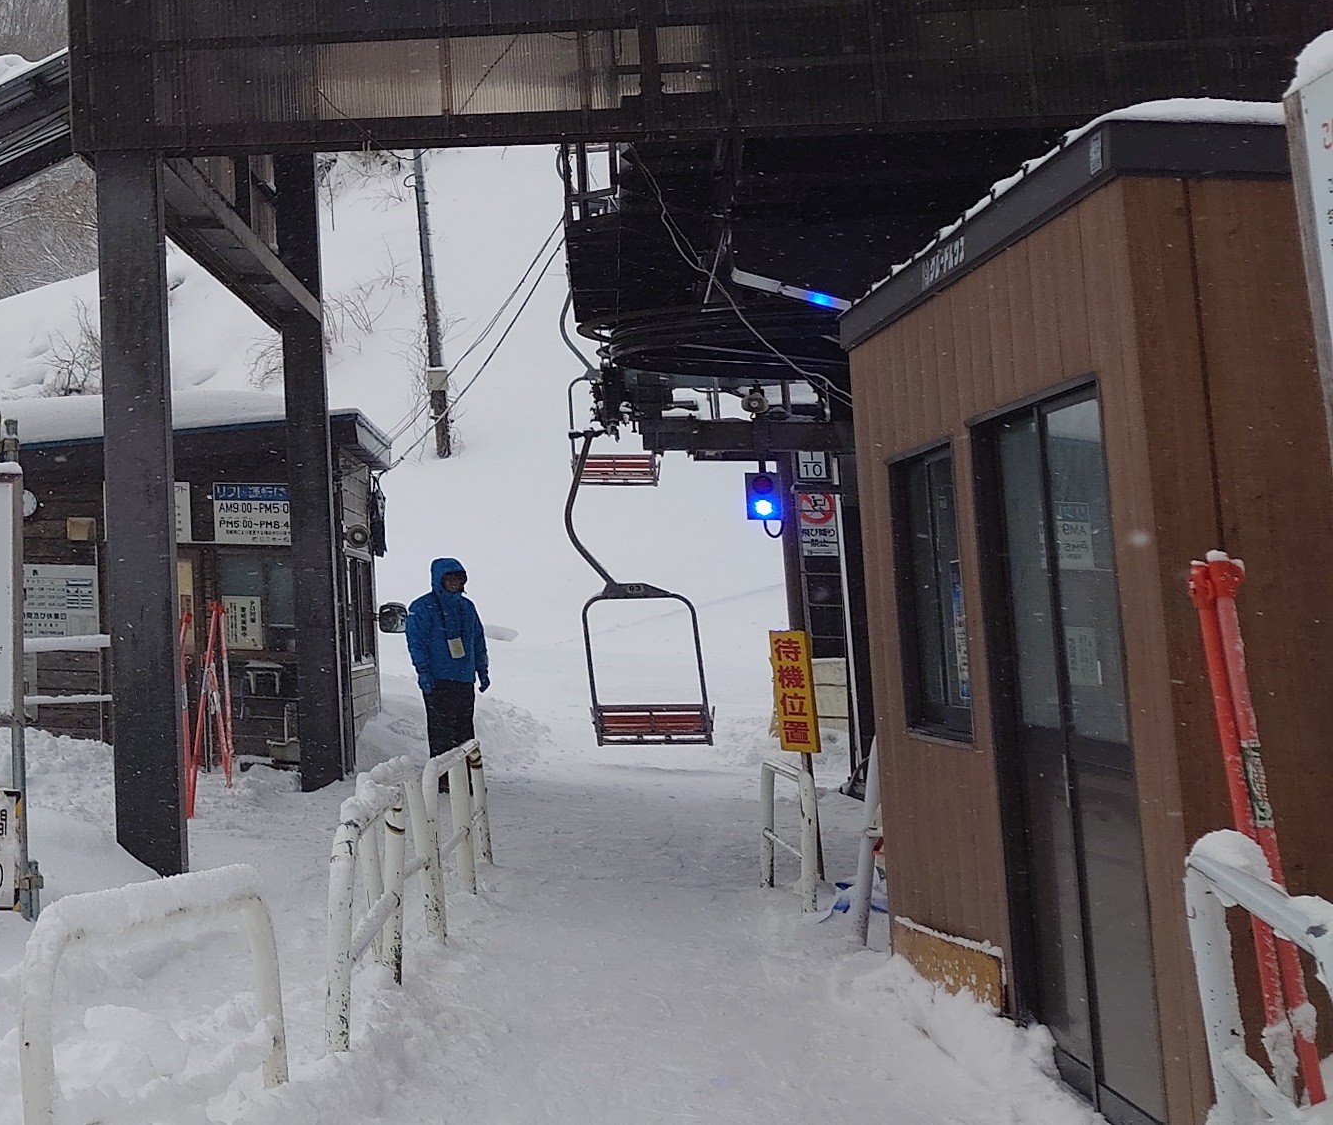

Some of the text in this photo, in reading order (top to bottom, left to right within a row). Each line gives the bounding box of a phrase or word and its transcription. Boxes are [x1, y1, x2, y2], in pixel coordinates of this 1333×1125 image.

[802, 463, 823, 477] 10
[773, 637, 811, 745] 待機位置
